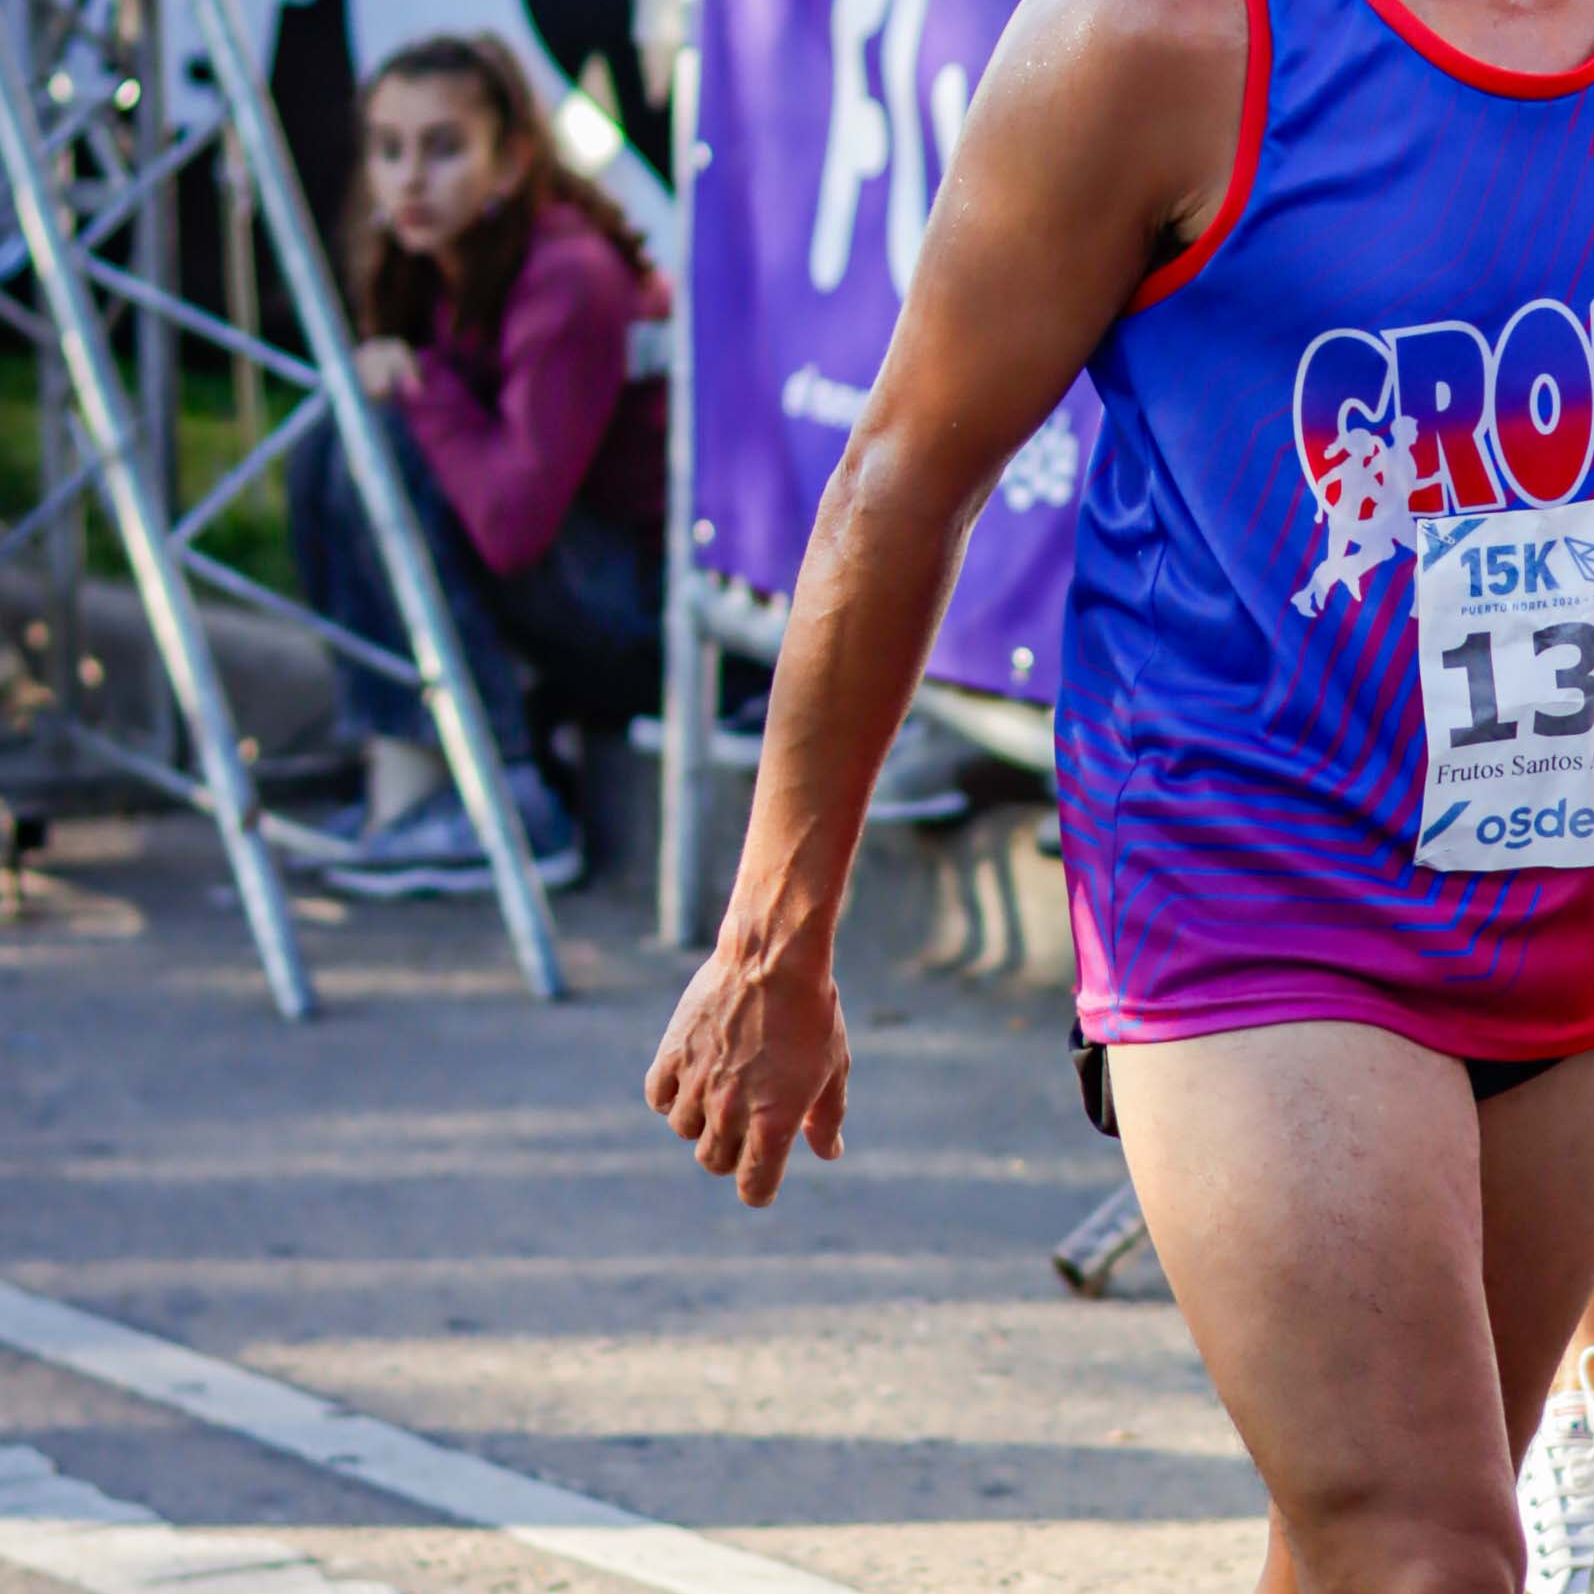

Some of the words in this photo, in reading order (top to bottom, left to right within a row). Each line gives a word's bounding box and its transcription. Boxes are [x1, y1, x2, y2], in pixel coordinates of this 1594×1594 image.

[1460, 538, 1561, 598] 15K
[1436, 763, 1504, 785] Frutos
[1511, 753, 1584, 777] Santos
